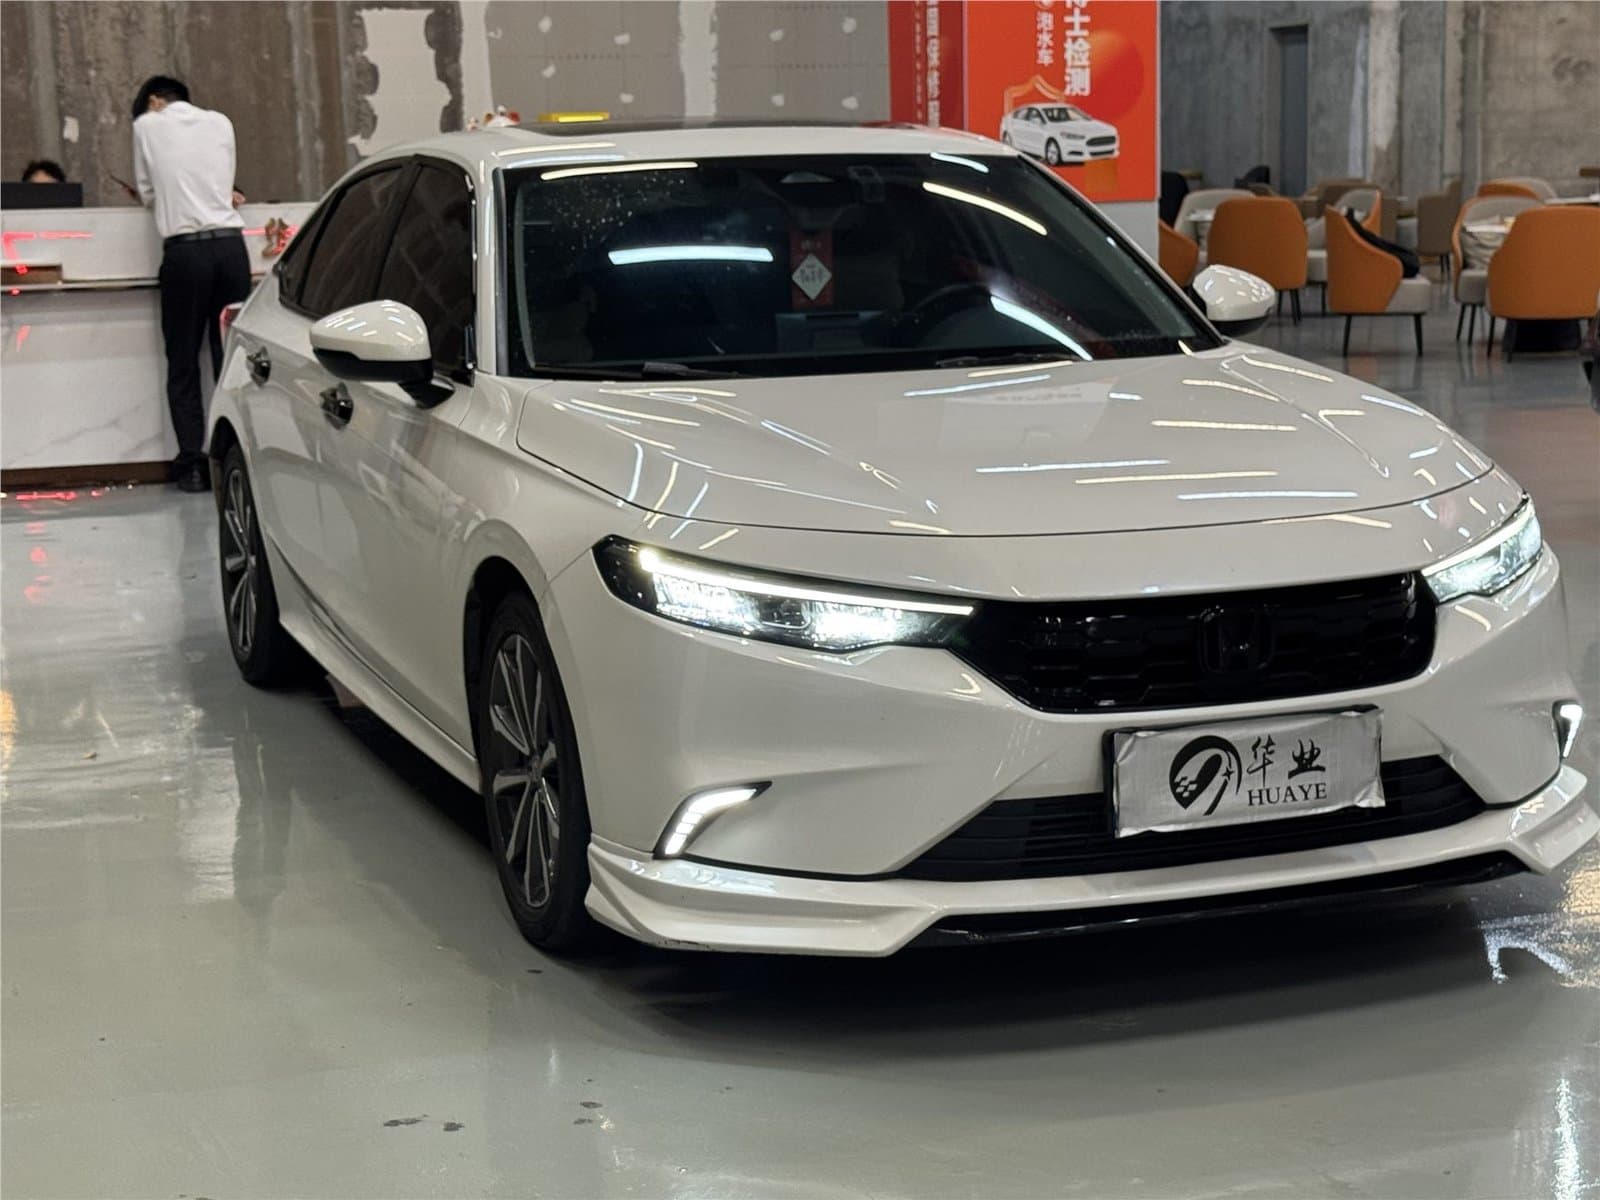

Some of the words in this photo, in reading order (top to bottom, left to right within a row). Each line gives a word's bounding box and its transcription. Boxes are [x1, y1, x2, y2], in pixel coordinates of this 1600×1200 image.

[1063, 0, 1092, 97] 士检测
[1246, 734, 1327, 787] 华业
[1247, 782, 1328, 807] HUAYE
